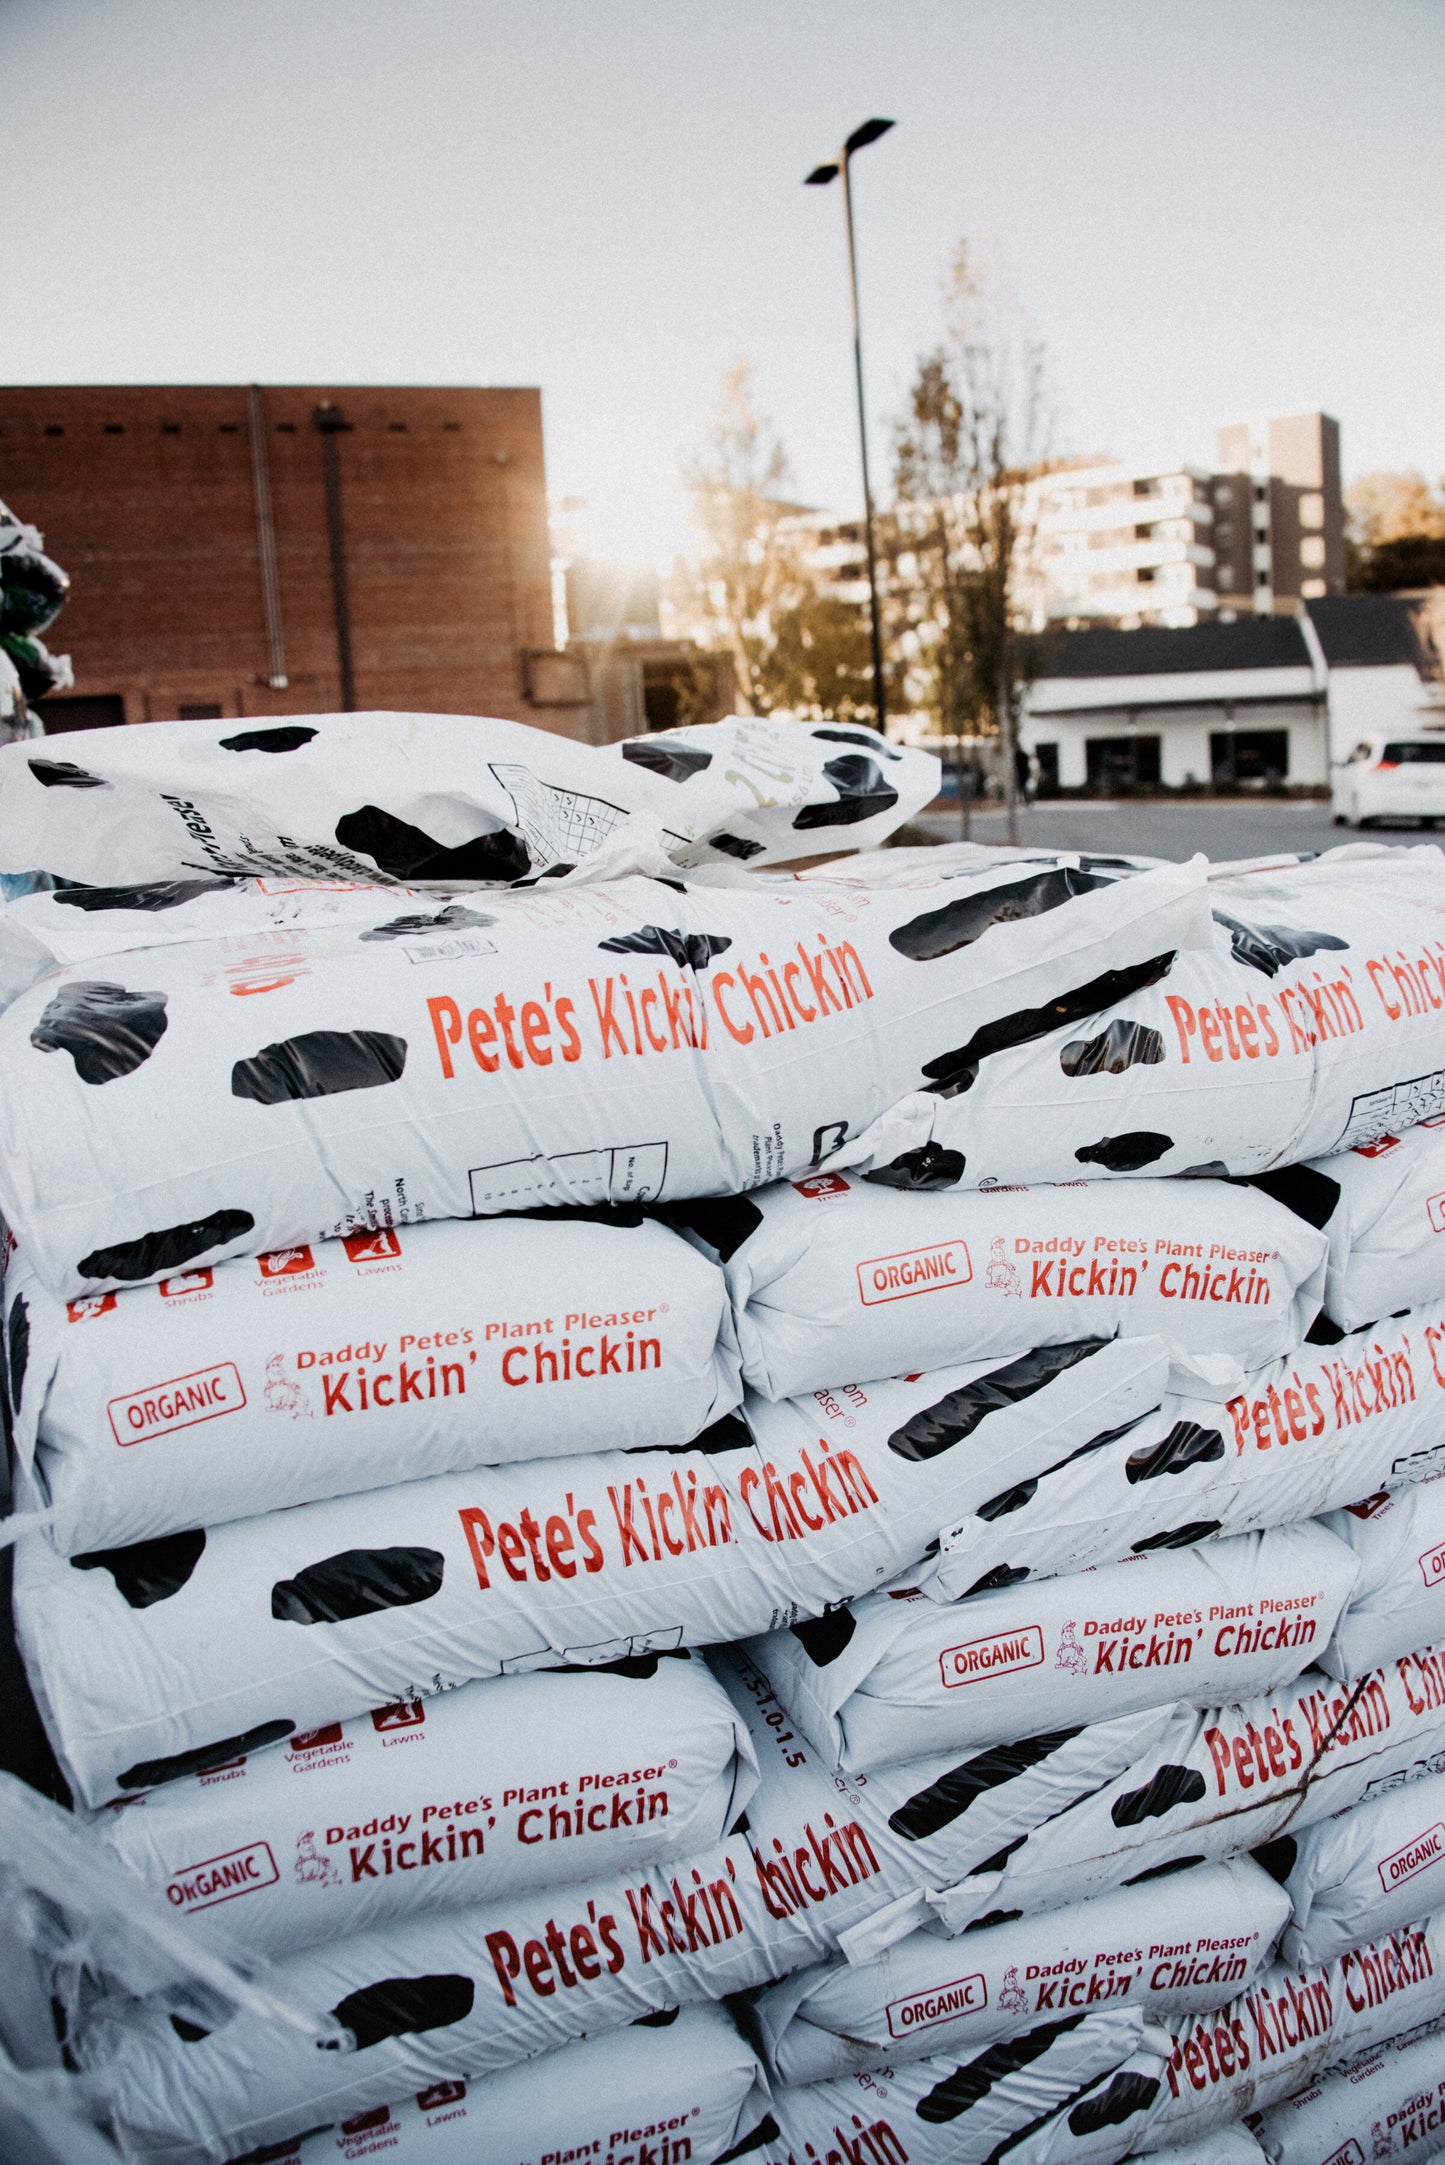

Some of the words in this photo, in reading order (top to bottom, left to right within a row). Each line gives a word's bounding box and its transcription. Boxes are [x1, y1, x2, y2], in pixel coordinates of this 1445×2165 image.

[427, 982, 581, 1079] Pete's
[712, 933, 874, 1045] Chickin
[1165, 995, 1278, 1064] Pete's
[1271, 966, 1363, 1056] Kikin'
[772, 1123, 784, 1150] Daddy
[364, 1189, 376, 1208] The
[394, 1177, 409, 1207] North
[1015, 1237, 1085, 1257] Daddy
[1094, 1236, 1147, 1253] Pete's
[1155, 1240, 1202, 1258] Plant
[253, 1267, 328, 1288] Vegetable
[262, 1279, 323, 1296] Gardens
[355, 1261, 402, 1276] Lawns
[872, 1250, 957, 1292] ORGANIC
[1031, 1259, 1148, 1298] Kickin'
[1160, 1262, 1270, 1304] Chickin
[297, 1342, 387, 1370] Daddy
[400, 1330, 474, 1354] Pete's
[485, 1318, 553, 1341] Plant
[126, 1376, 227, 1431] ORGANIC
[321, 1349, 477, 1416] Kickin'
[502, 1330, 661, 1386] Chickin
[1225, 1371, 1326, 1456] Pete's
[1370, 1500, 1389, 1518] Trees
[458, 1493, 604, 1590] Pete's
[1084, 1617, 1146, 1638] Daddy
[1154, 1612, 1202, 1628] Pete's
[1209, 1603, 1253, 1621] Plant
[952, 1635, 1031, 1676] ORGANIC
[1093, 1627, 1203, 1674] Kickin'
[1212, 1613, 1316, 1657] Chickin
[288, 1739, 351, 1764] Vegetable
[381, 1729, 425, 1747] Lawns
[1204, 1706, 1303, 1796] Pete's
[199, 1767, 246, 1785] Shrubs
[292, 1752, 350, 1773] Gardens
[326, 1814, 412, 1846] Daddy
[422, 1796, 493, 1824] Pete's
[503, 1781, 568, 1808] Plant
[348, 1814, 496, 1882] Kickin'
[516, 1786, 669, 1844] Chickin
[1388, 1833, 1442, 1881] ORGANIC
[484, 1900, 624, 2006] Pete's
[625, 1856, 743, 1962] Kckin'
[1026, 1958, 1088, 1982] Daddy
[1094, 1950, 1142, 1970] Pete's
[1148, 1942, 1191, 1959] Plant
[900, 1984, 975, 2026] ORGANIC
[1033, 1965, 1143, 2011] Kickin'
[1148, 1952, 1247, 1990] Chickin
[1245, 1963, 1332, 2062] Kickin'
[1349, 2060, 1385, 2084] Gardens
[426, 2106, 467, 2127] Lawns
[1292, 2087, 1323, 2110] Shrubs
[1386, 2092, 1434, 2130] Daddy
